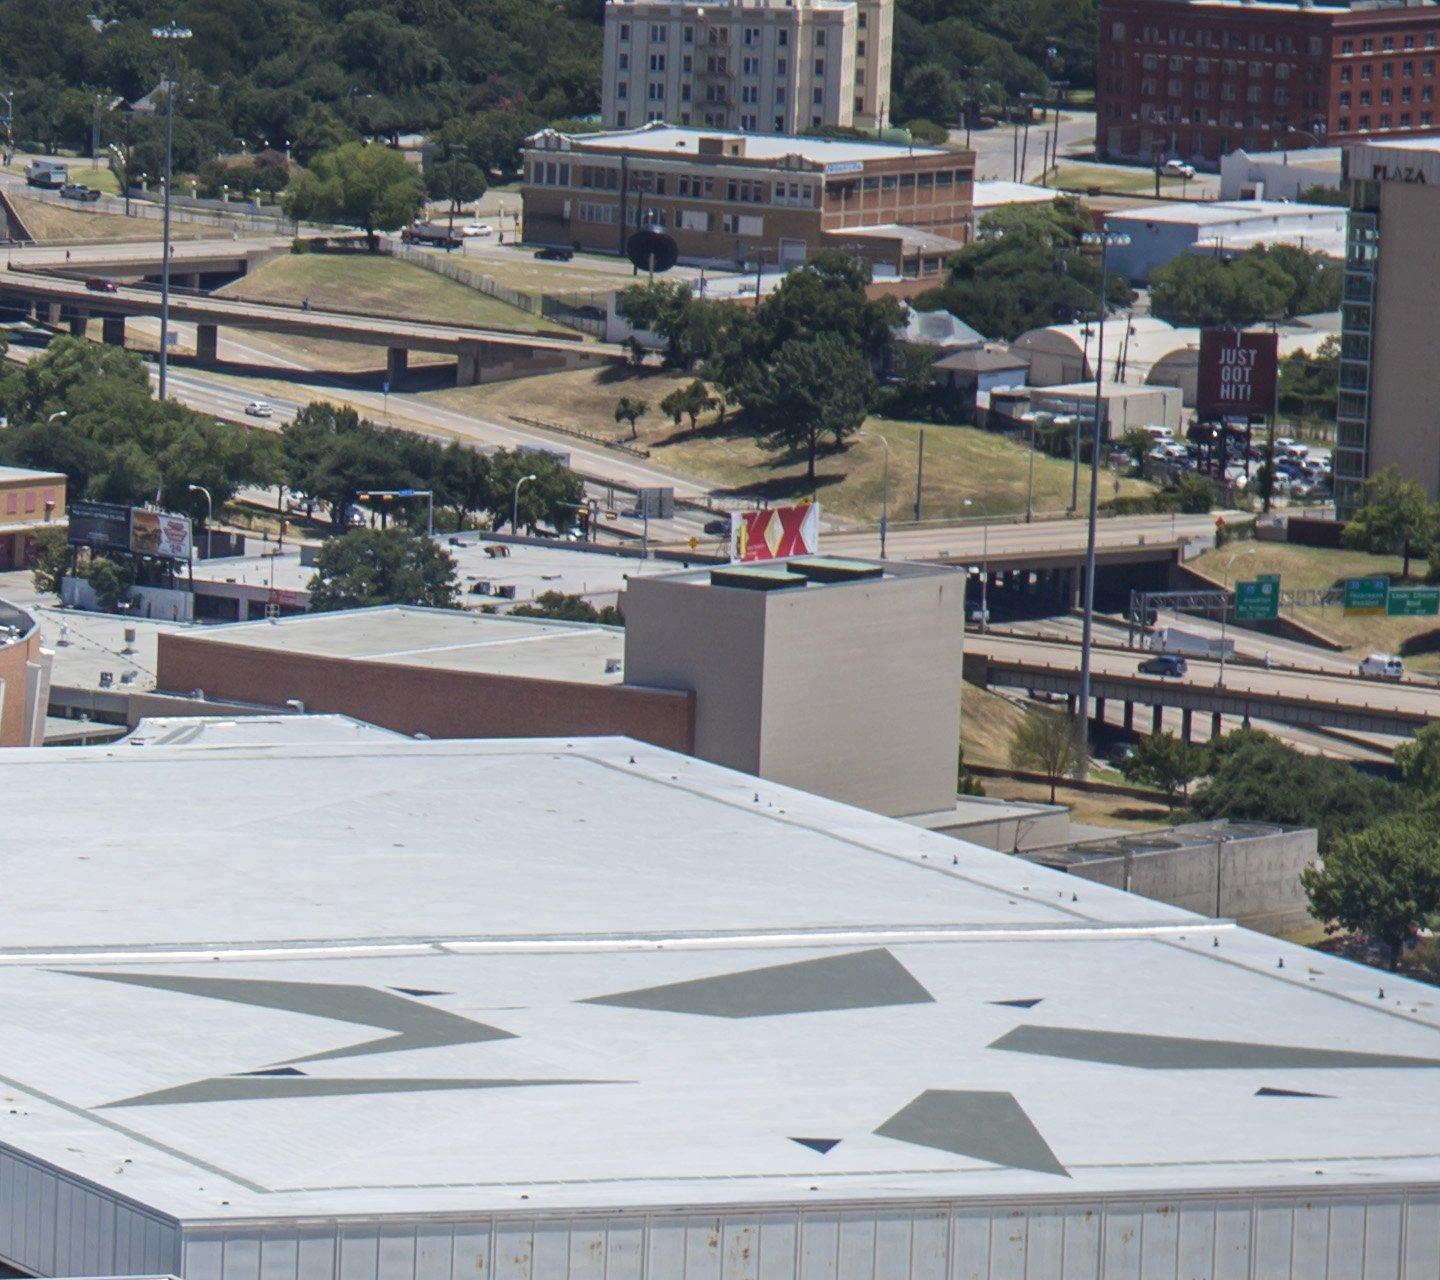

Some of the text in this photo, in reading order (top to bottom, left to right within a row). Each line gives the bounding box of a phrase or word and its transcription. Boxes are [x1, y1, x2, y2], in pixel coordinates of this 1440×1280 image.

[1373, 164, 1427, 184] PLAZA
[1219, 347, 1258, 366] JUST
[1221, 366, 1252, 383] GOT
[1220, 383, 1251, 401] HIT!
